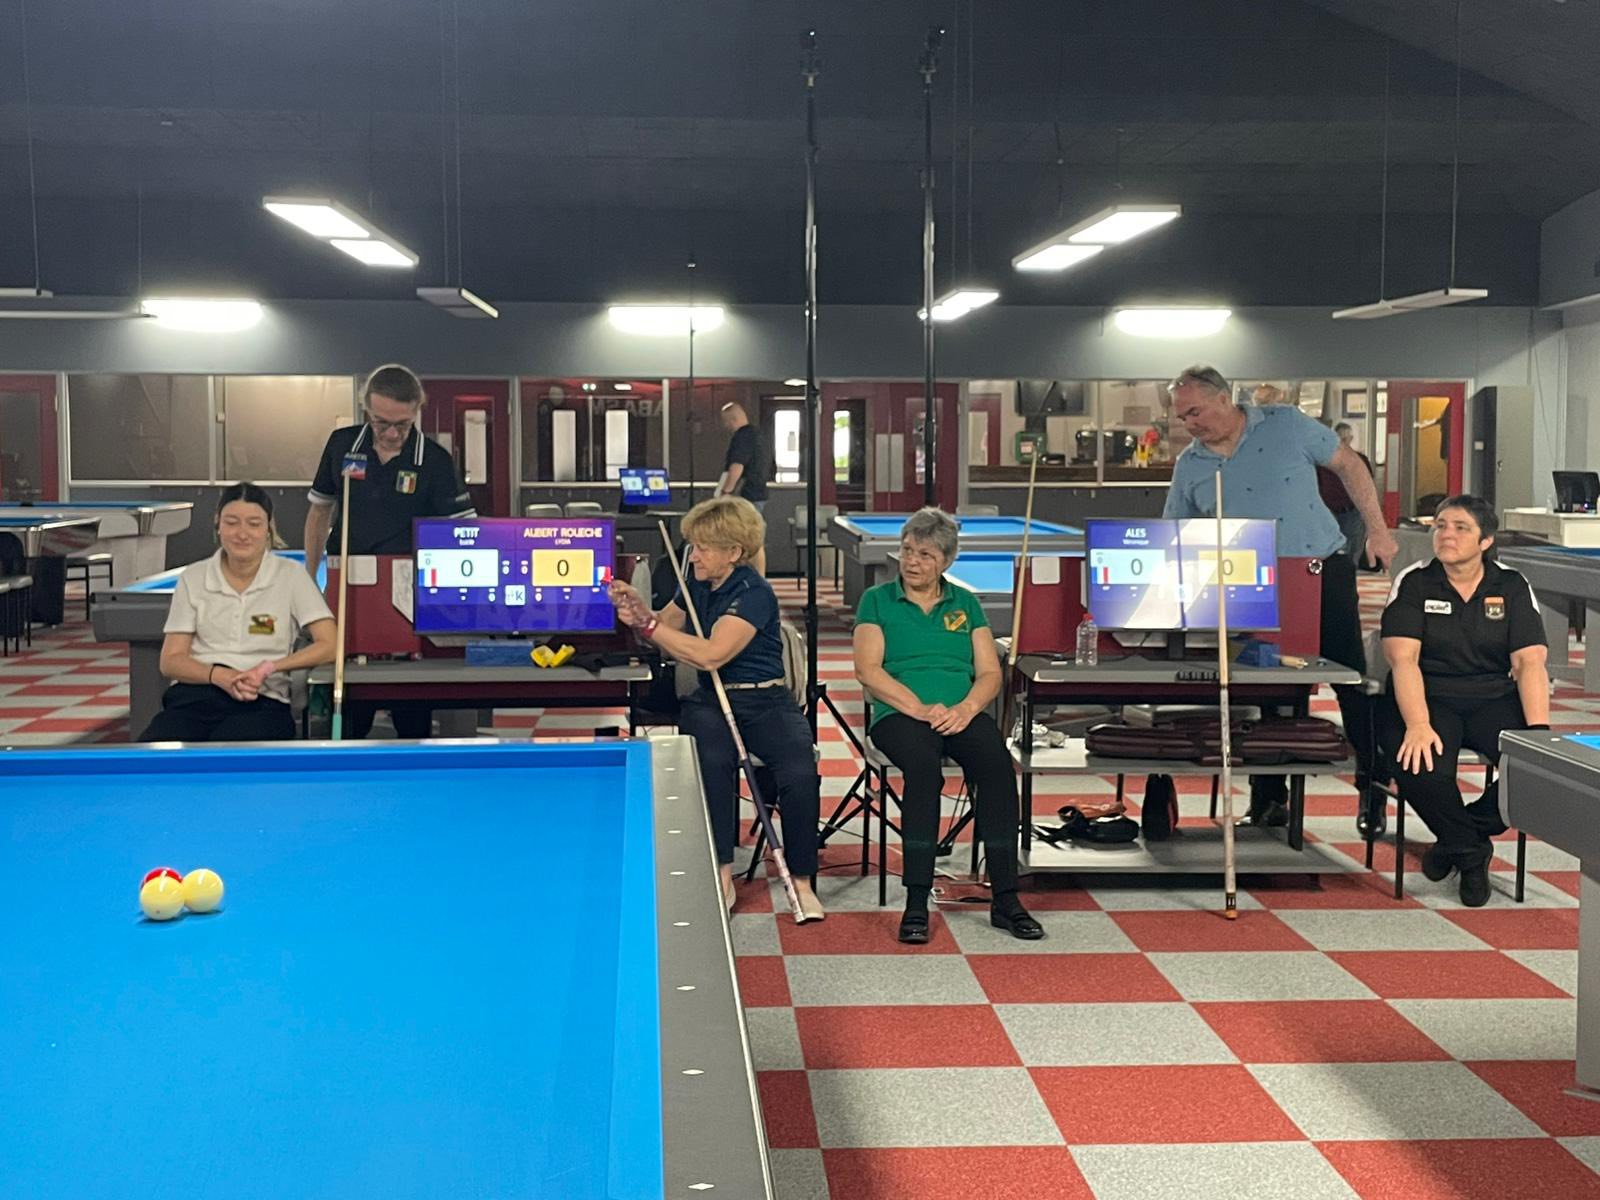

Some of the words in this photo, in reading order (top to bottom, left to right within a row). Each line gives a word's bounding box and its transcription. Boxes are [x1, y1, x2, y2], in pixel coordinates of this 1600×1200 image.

[454, 527, 480, 538] PETIT
[523, 527, 558, 538] ALBERT
[1125, 527, 1147, 538] ALES
[461, 559, 473, 577] 0
[557, 559, 569, 577] 0
[1131, 558, 1143, 576] 0
[1222, 559, 1234, 576] 0
